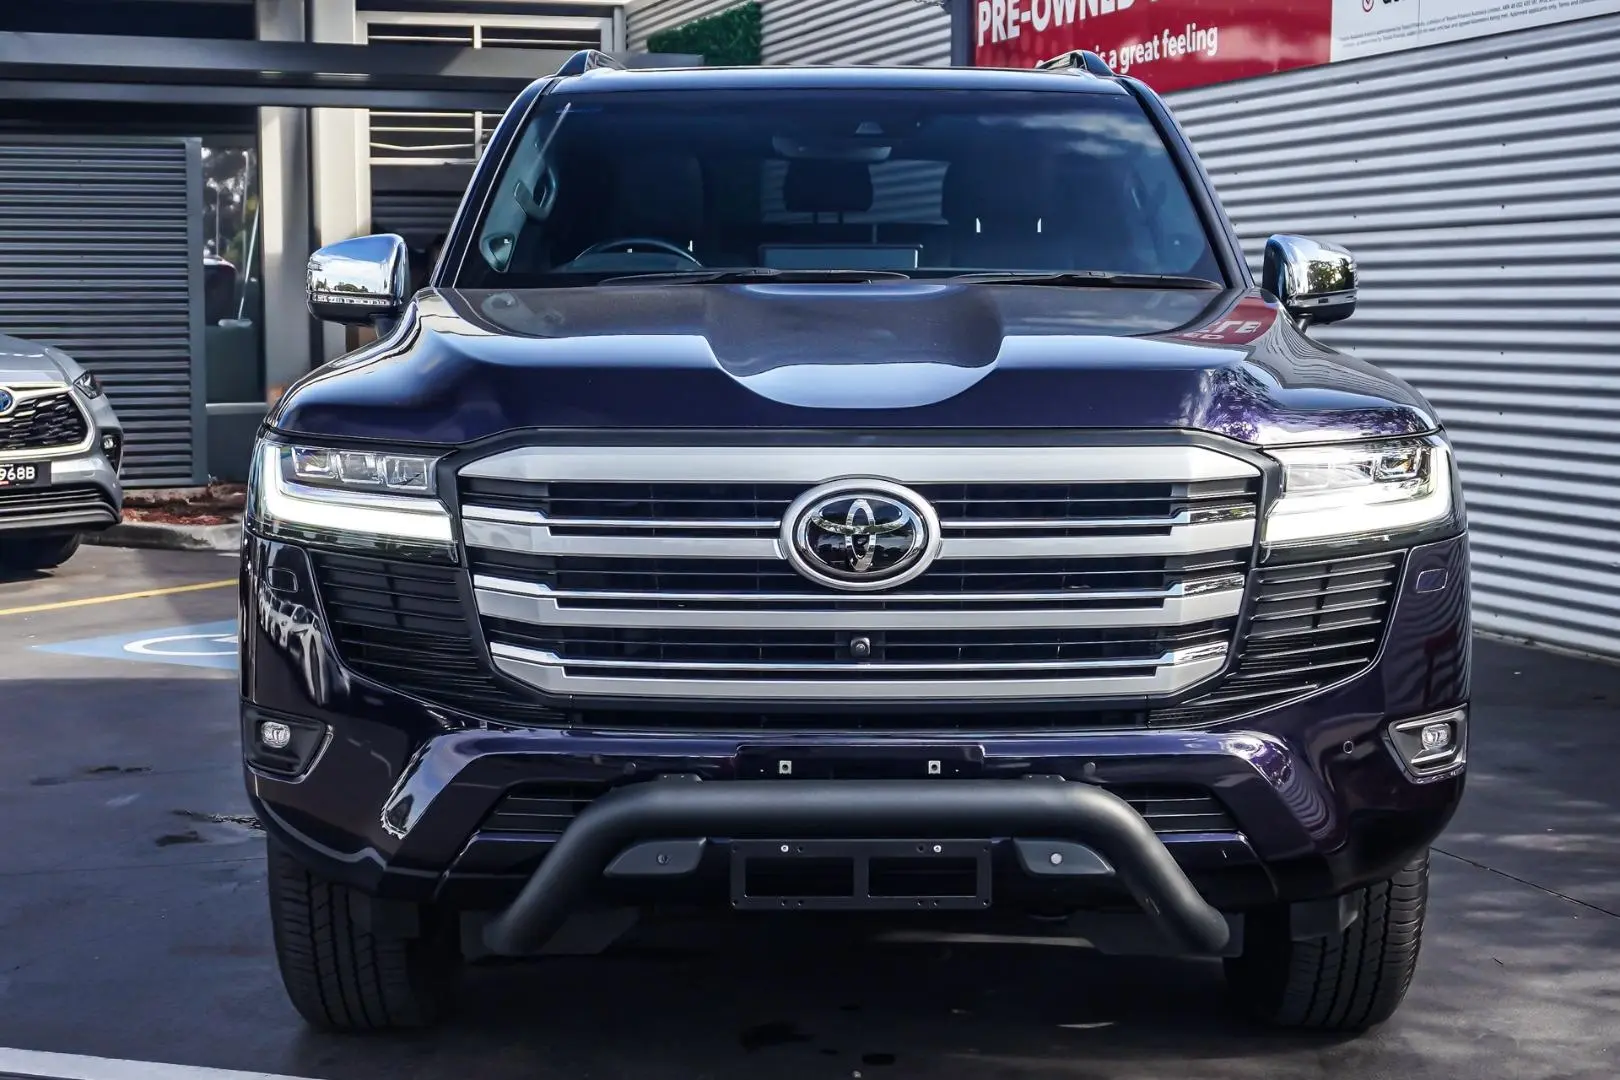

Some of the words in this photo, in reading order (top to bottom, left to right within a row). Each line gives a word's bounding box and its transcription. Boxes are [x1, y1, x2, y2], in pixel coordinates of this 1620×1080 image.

[978, 0, 1136, 47] PRE-OWN
[1109, 49, 1117, 69] a
[1120, 34, 1160, 74] great
[1162, 23, 1218, 56] feeling
[0, 466, 35, 480] 968B
